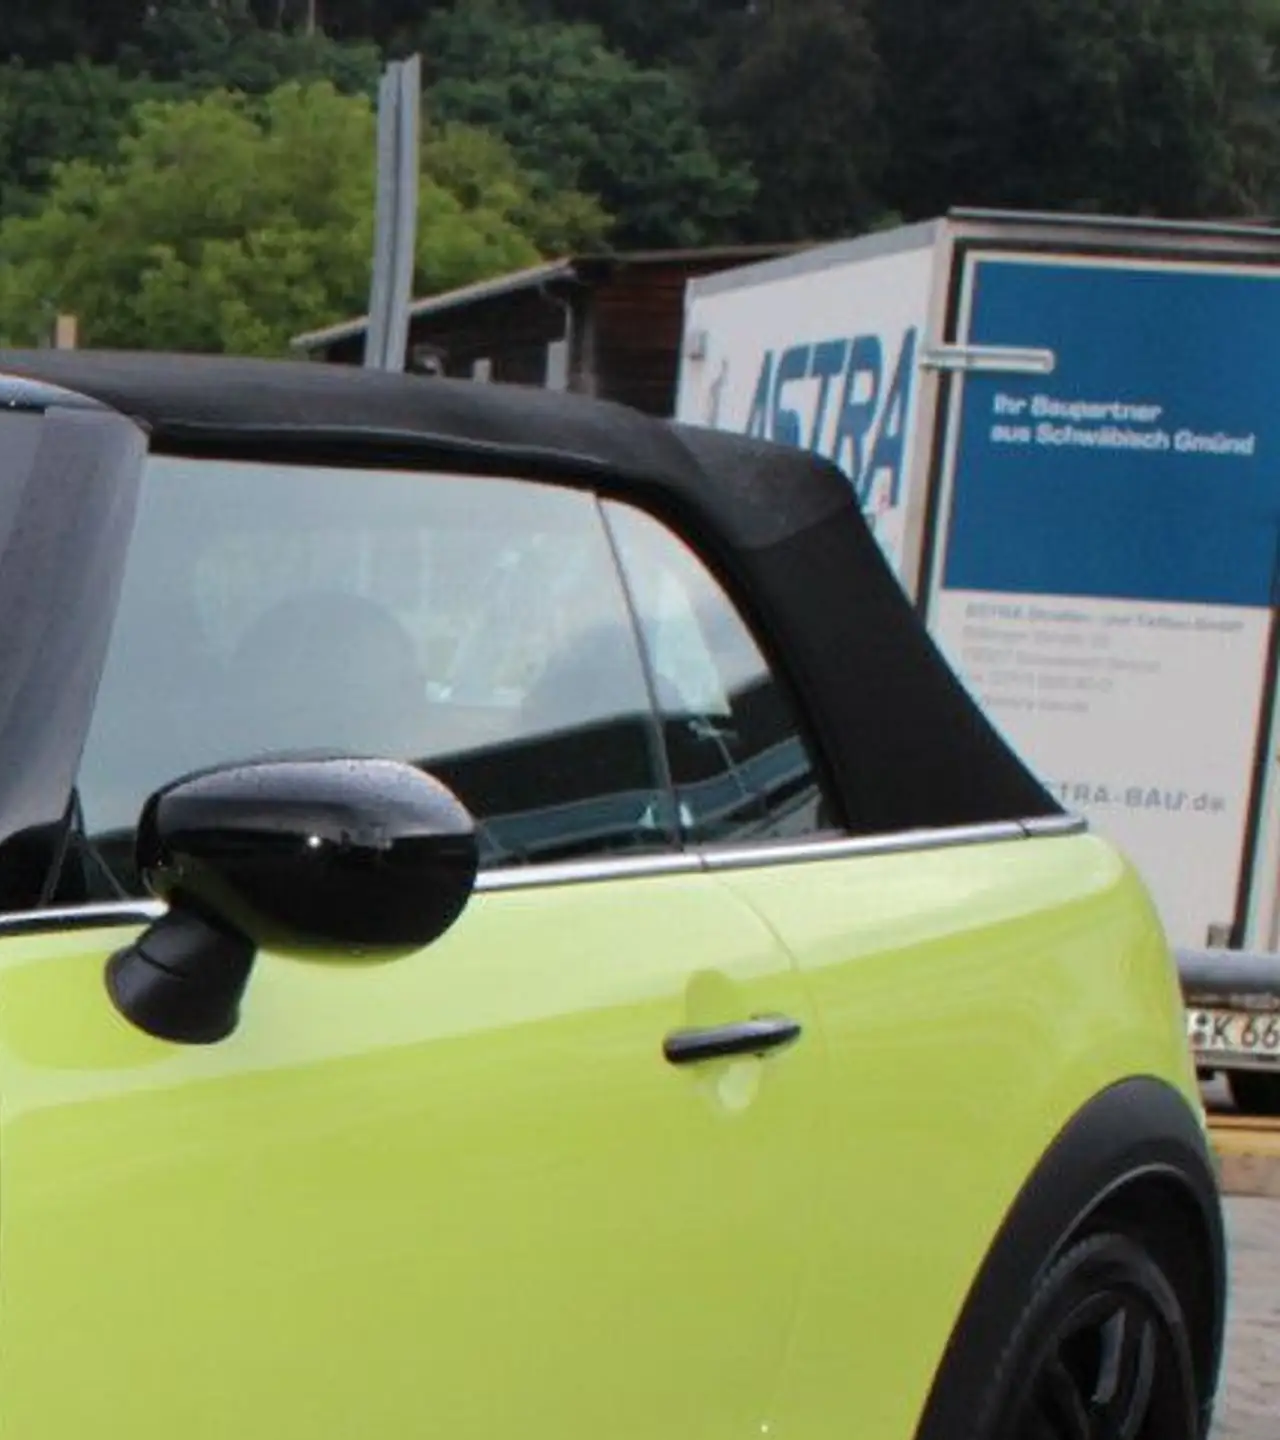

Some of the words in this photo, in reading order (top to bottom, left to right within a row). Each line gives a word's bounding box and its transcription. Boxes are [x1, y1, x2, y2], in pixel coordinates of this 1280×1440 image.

[746, 324, 918, 508] ASTRA
[994, 393, 1027, 415] Ihr
[1031, 395, 1162, 421] Baupartner
[992, 424, 1030, 442] aus
[1036, 422, 1170, 449] Schwäbisch
[1174, 429, 1255, 455] Gmünd
